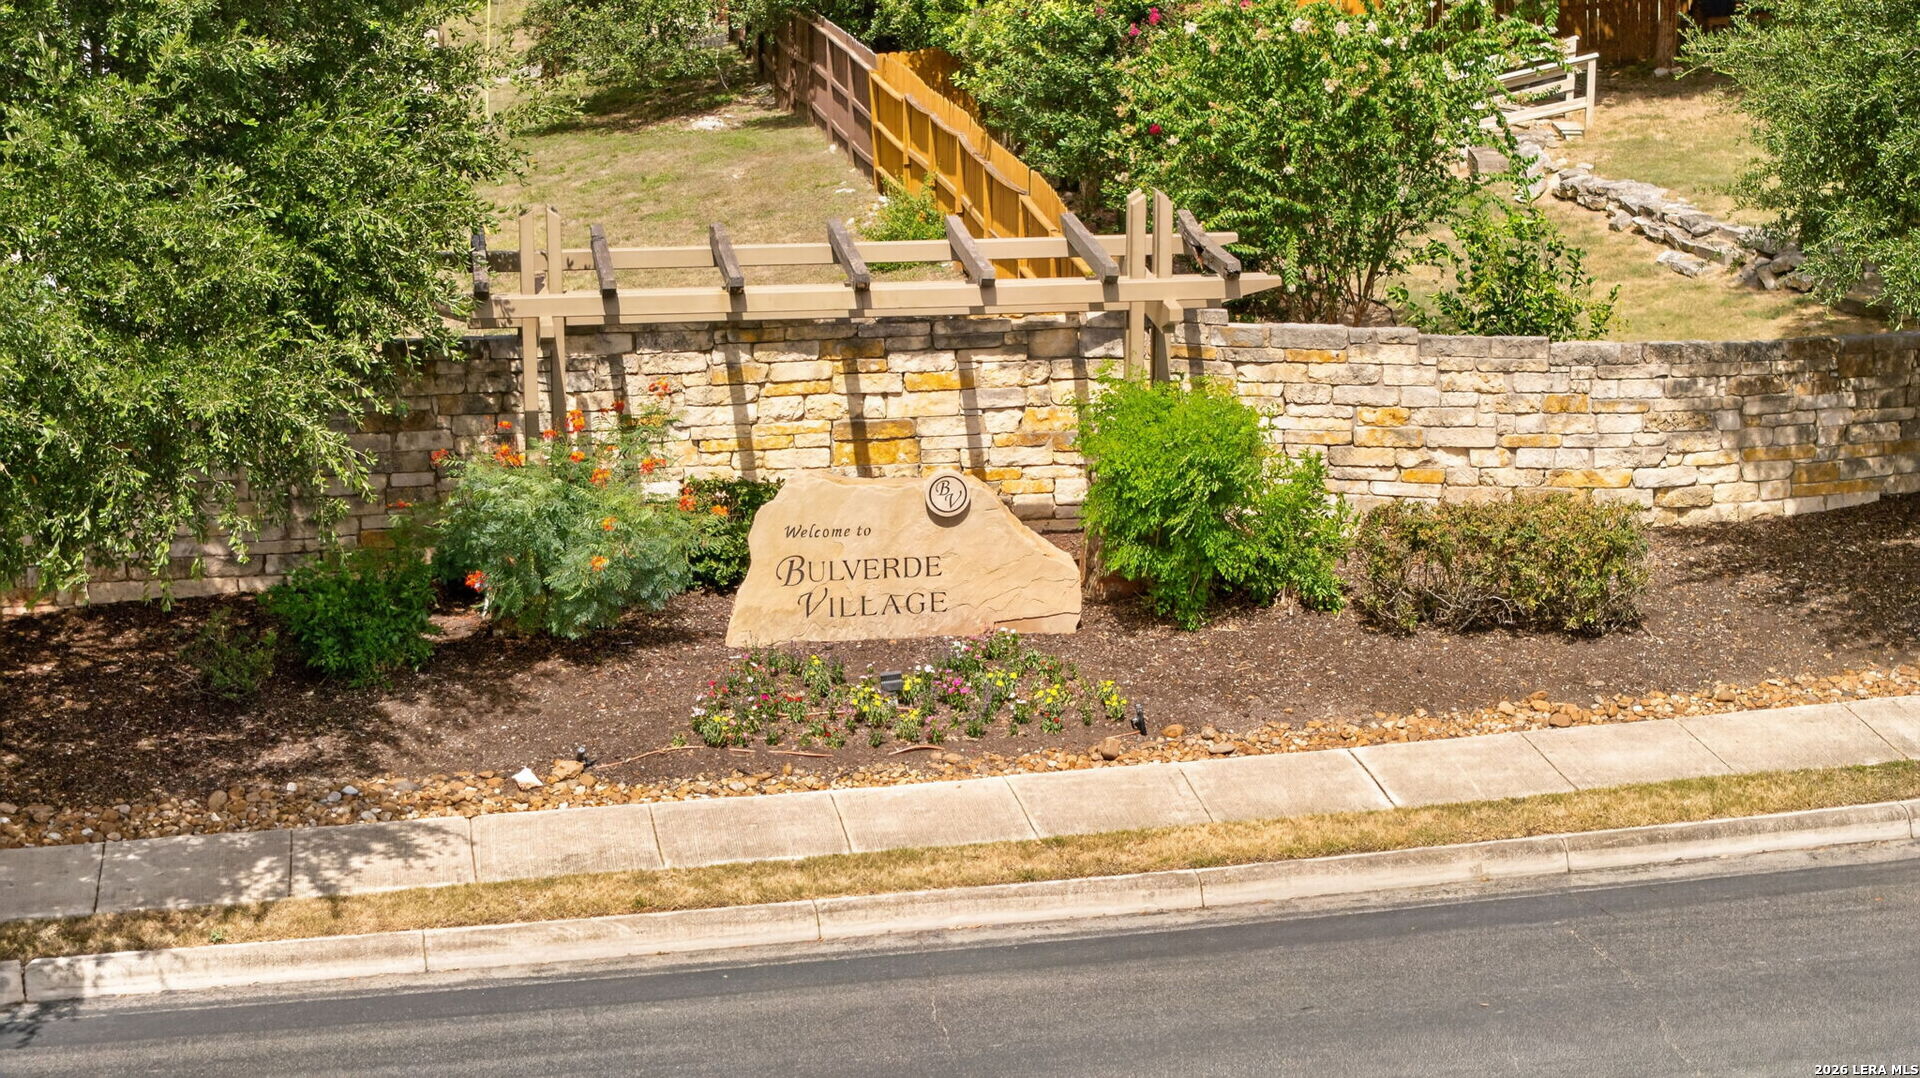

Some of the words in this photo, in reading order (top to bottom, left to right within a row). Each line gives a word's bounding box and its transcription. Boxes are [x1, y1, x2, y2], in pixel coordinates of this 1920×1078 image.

[784, 523, 851, 539] Welcome
[856, 525, 872, 537] to
[775, 555, 943, 587] BULVERDE
[797, 588, 949, 619] VILLAGE
